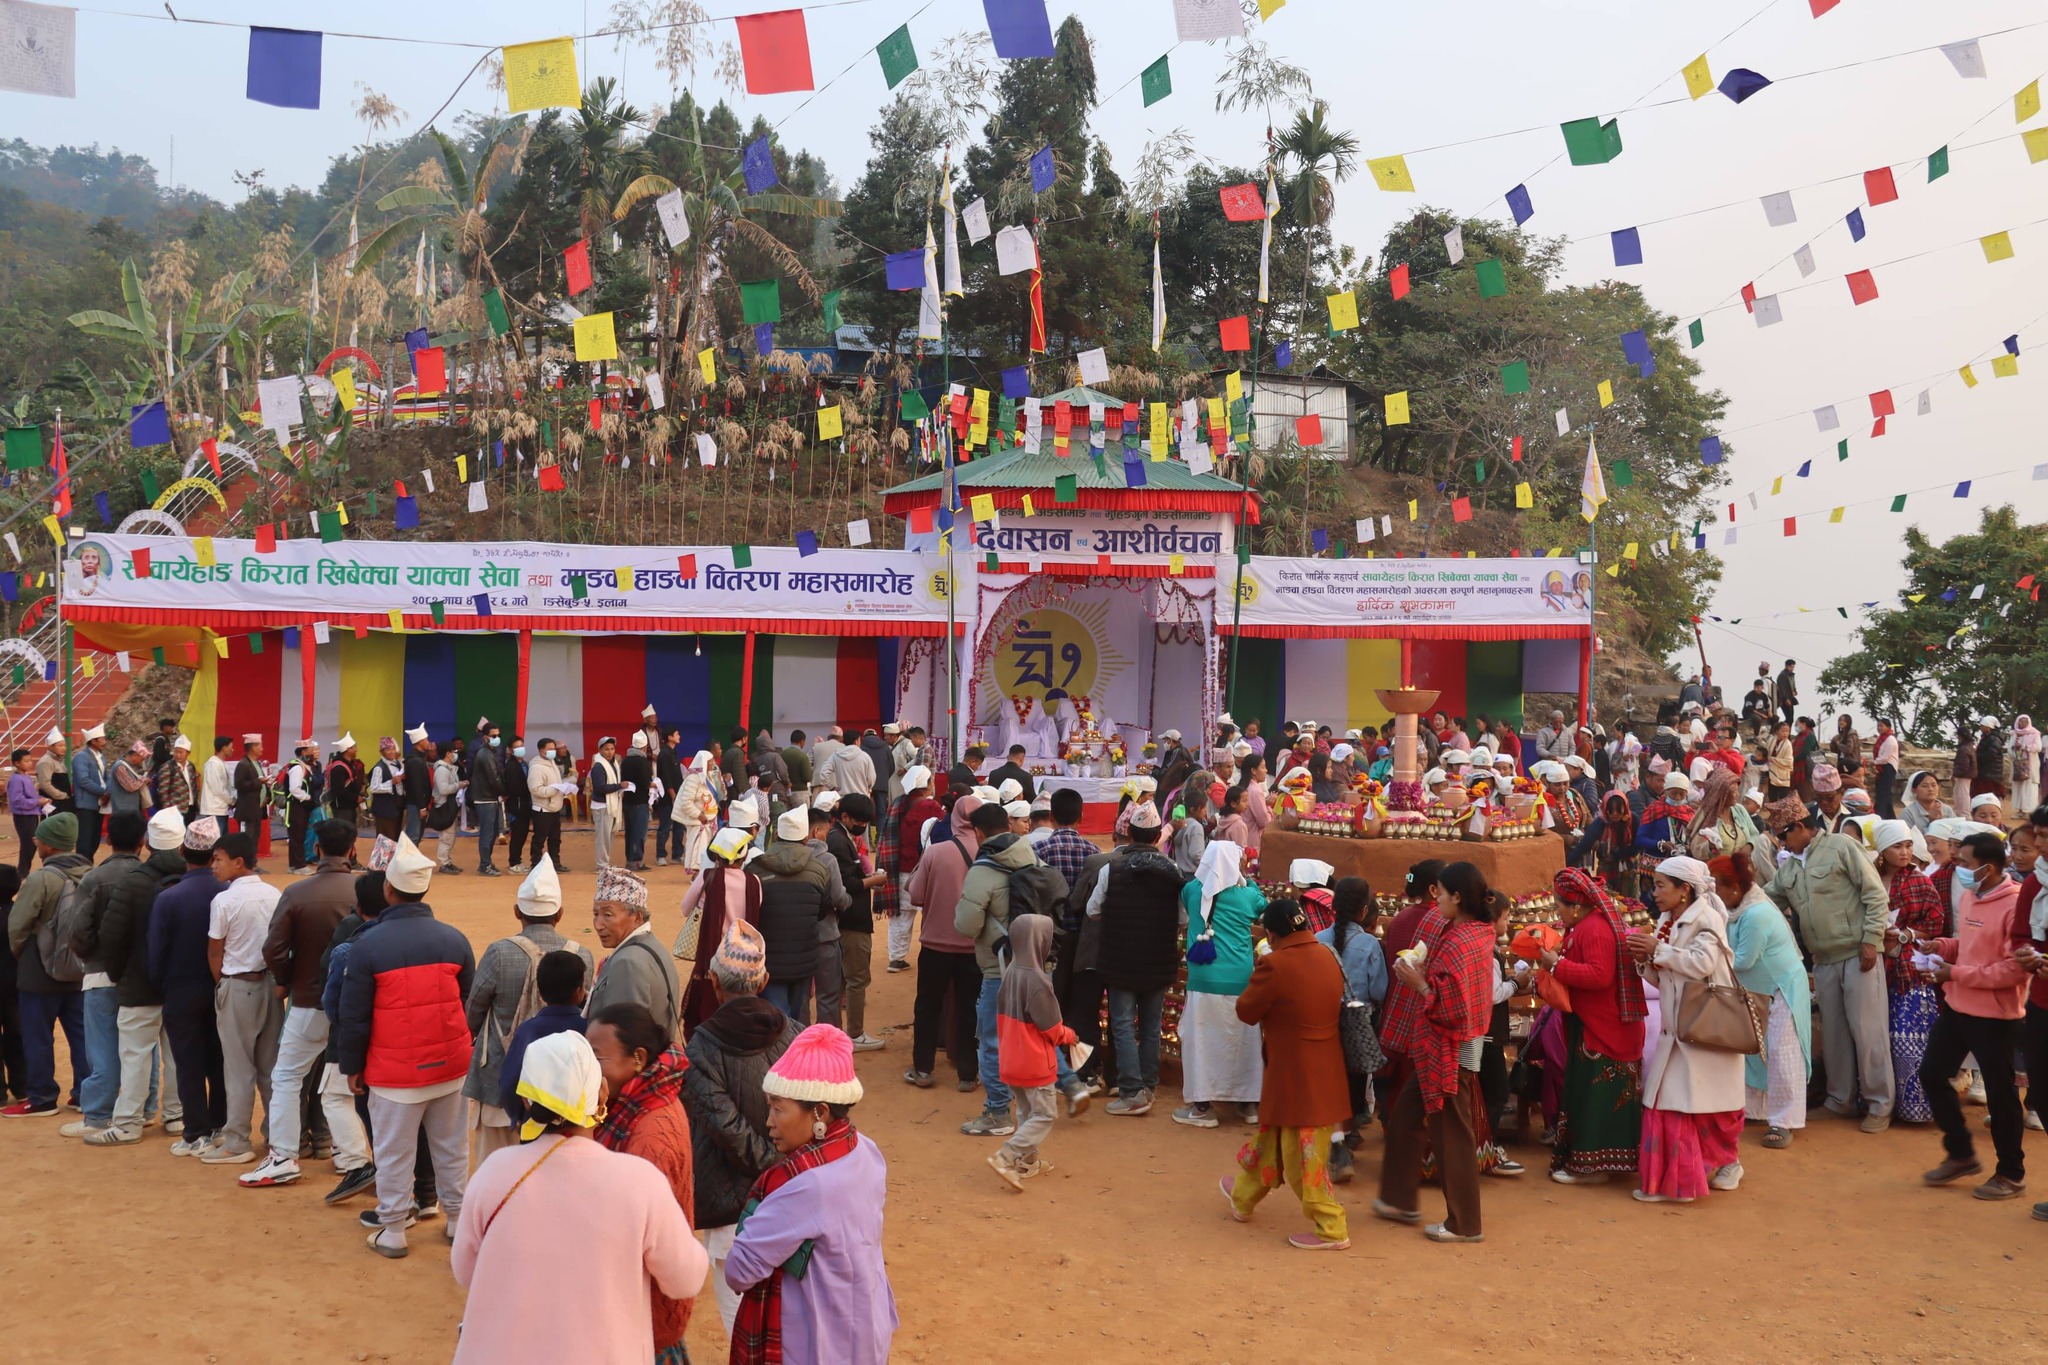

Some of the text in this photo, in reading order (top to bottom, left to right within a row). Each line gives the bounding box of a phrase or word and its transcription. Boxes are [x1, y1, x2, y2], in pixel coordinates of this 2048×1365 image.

[976, 520, 1073, 552] देवासन
[1092, 523, 1222, 555] आशीर्वचन
[121, 554, 234, 584] सवायेहाङ
[241, 556, 310, 586] किरात
[317, 558, 399, 587] खिबेक्वा
[406, 566, 472, 587] याक्वा
[478, 560, 521, 588] सेवा
[528, 574, 553, 588] तथा
[705, 563, 781, 592] वितरण
[788, 567, 915, 596] महासमारोह
[1278, 569, 1303, 581] किरात
[1333, 571, 1360, 582] महापर्व
[1408, 571, 1435, 582] किरात
[1501, 571, 1518, 582] सेवा
[1326, 584, 1354, 595] वितरण
[1356, 584, 1412, 595] महासमारोहको
[1413, 586, 1448, 595] अवसरमा
[442, 596, 463, 605] माघ
[512, 594, 529, 607] गते
[597, 598, 628, 609] इलाम
[1356, 596, 1457, 614] हार्दिक शुभकामना
